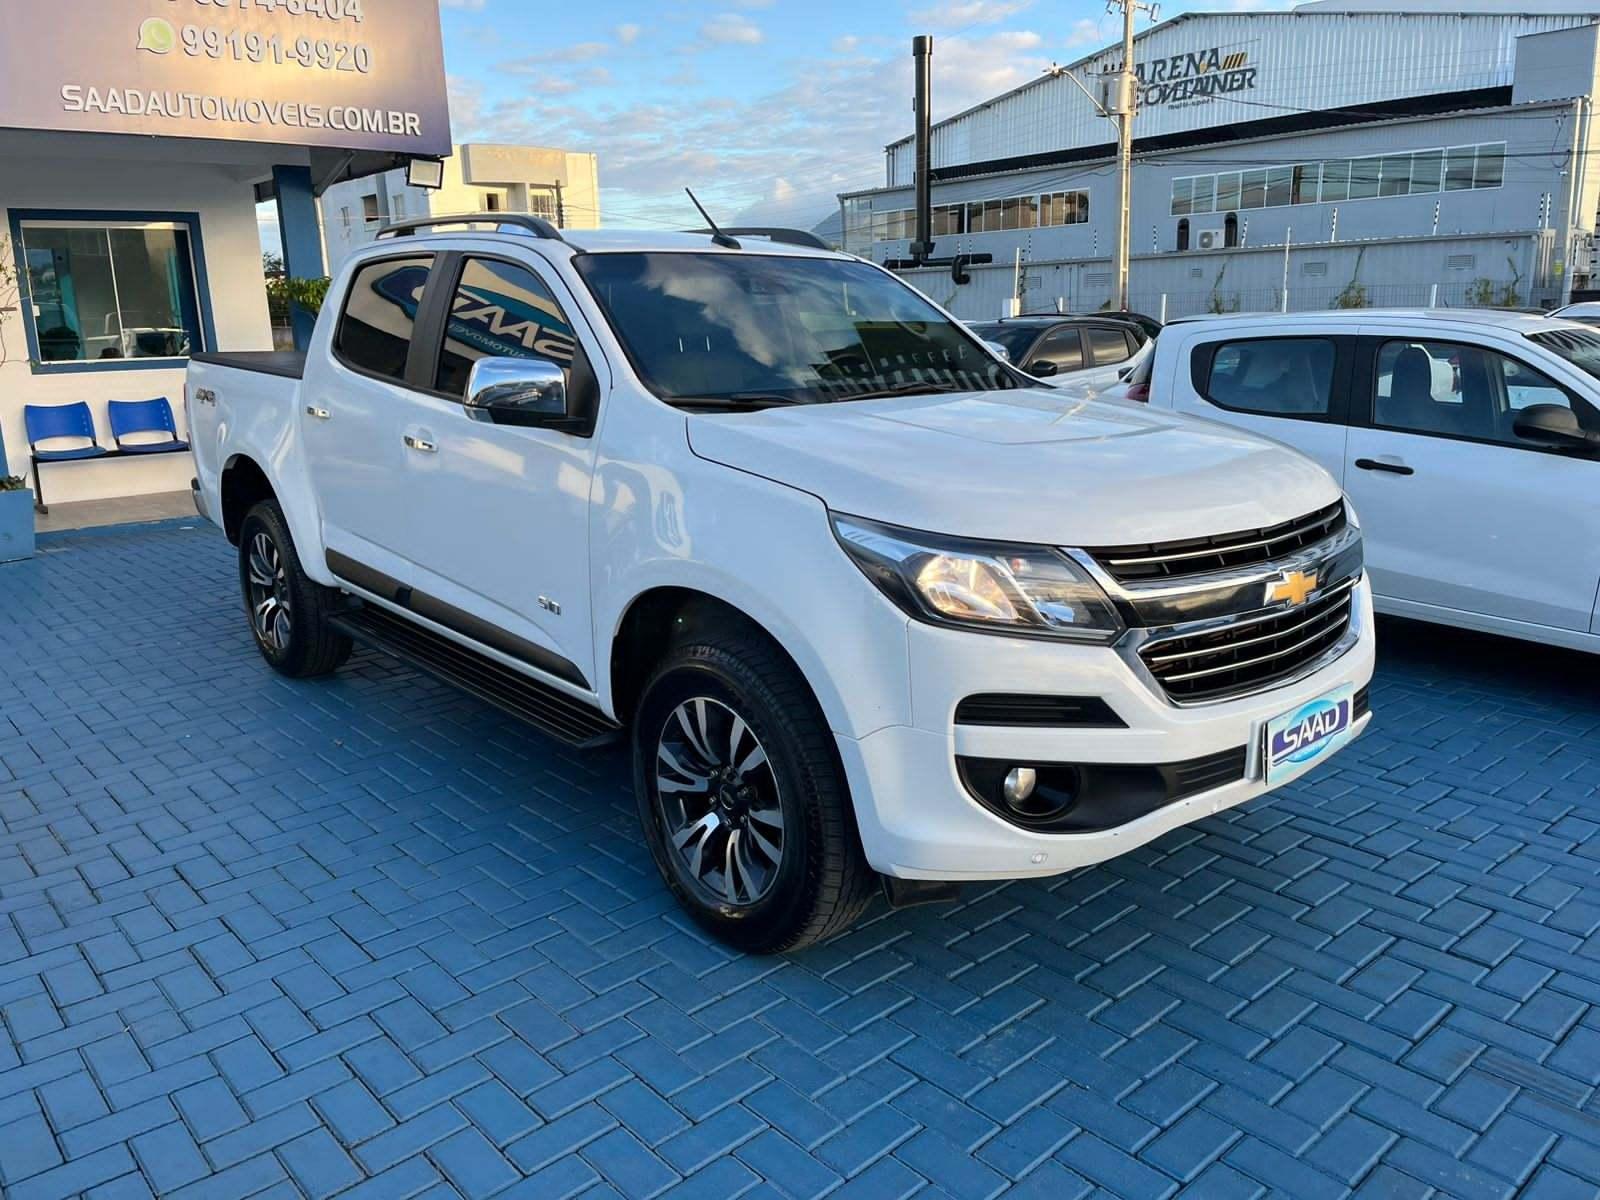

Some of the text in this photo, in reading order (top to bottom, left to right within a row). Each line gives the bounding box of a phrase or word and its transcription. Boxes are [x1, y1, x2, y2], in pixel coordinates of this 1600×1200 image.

[181, 24, 371, 73] 99191-9920
[1134, 47, 1221, 85] ARENA
[60, 84, 421, 136] SAADAUTOMOVEIS.COM.BR
[1272, 704, 1340, 757] SAAD
